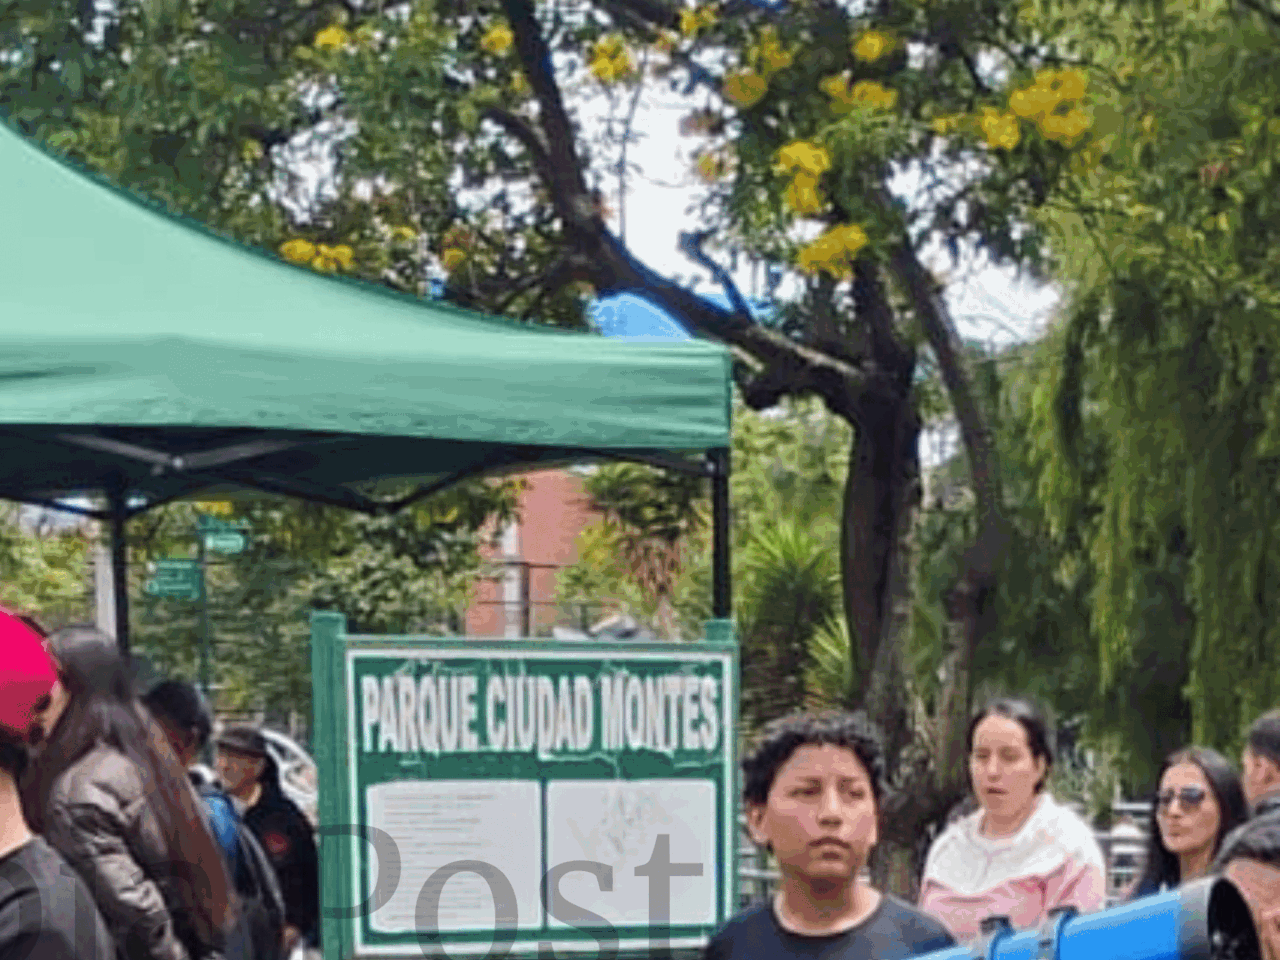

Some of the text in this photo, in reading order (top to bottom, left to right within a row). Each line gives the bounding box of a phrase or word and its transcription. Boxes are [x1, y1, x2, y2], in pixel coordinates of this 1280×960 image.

[361, 675, 719, 753] PARQUE CIUDAD MONTES
